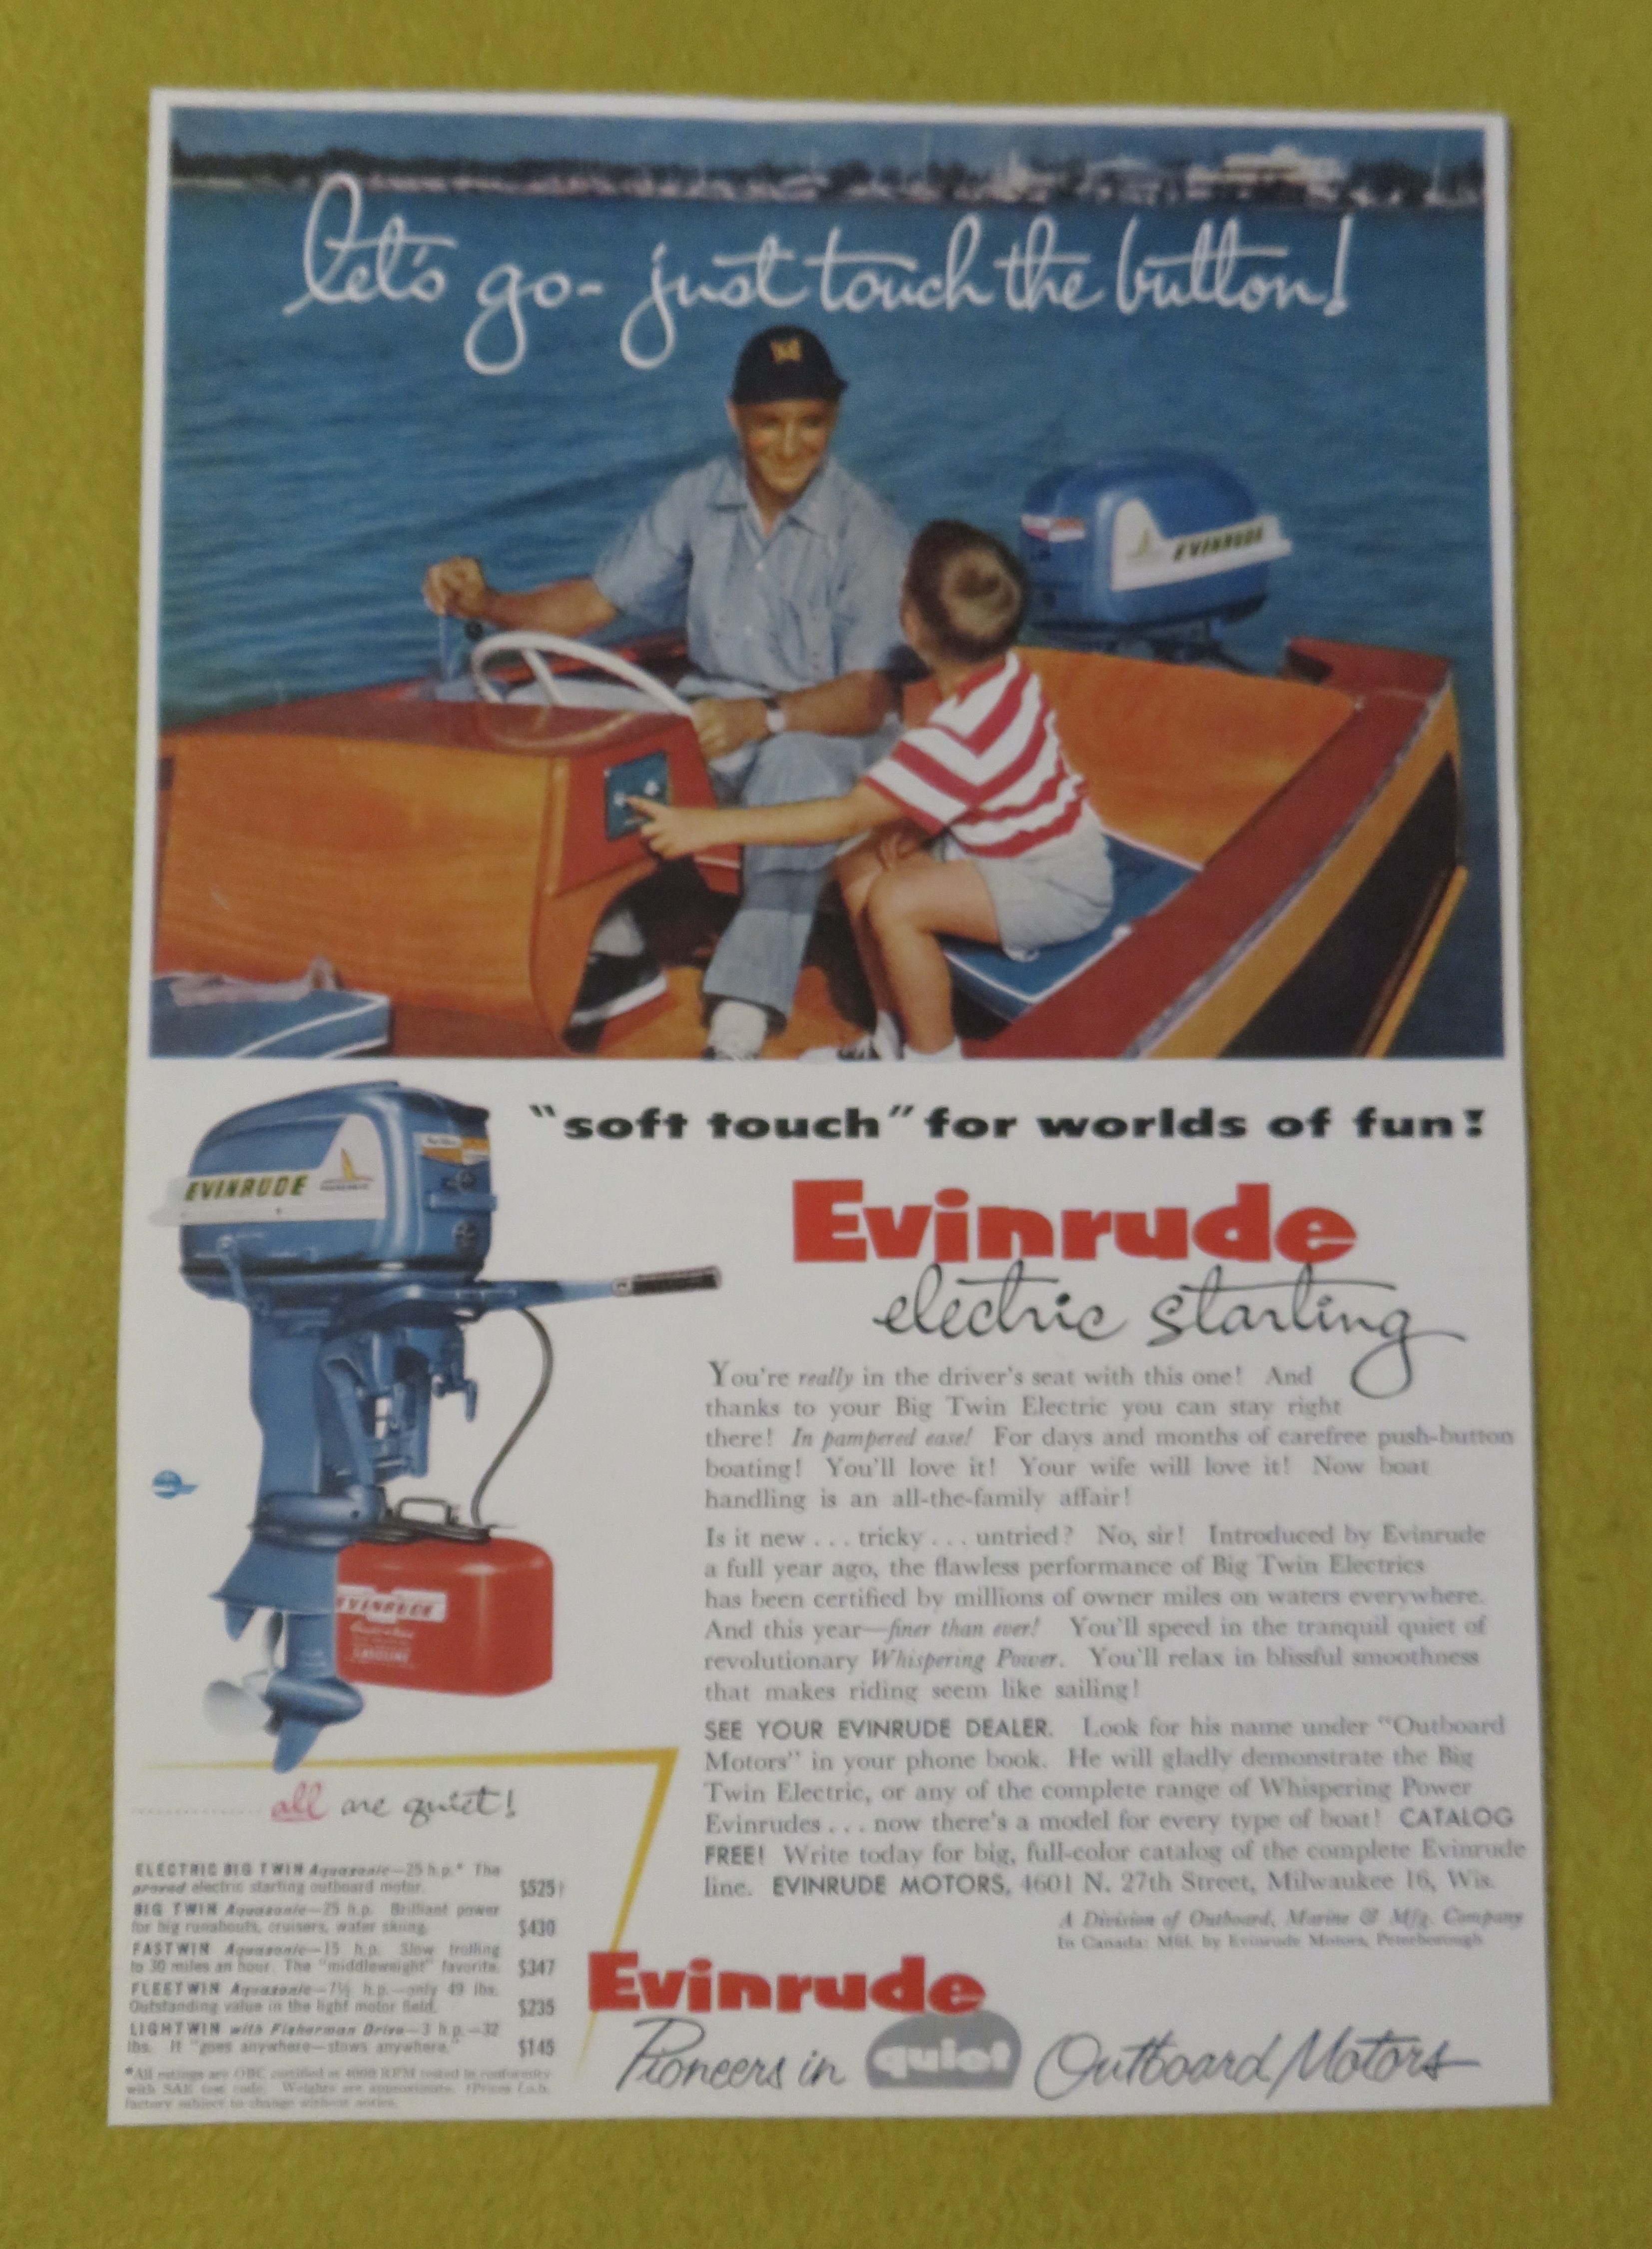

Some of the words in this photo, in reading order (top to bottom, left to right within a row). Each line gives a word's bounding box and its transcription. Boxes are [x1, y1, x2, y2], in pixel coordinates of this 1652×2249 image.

[619, 232, 810, 369] just
[802, 213, 994, 313] touch
[993, 214, 1105, 313] the
[1116, 213, 1353, 316] button!
[925, 1107, 1017, 1139] for
[1036, 1107, 1247, 1139] worlds
[1267, 1107, 1332, 1138] of
[1353, 1107, 1485, 1138] fun!
[185, 1173, 309, 1201] EVINRUDE
[792, 1179, 1358, 1263] Evinrude
[873, 1259, 1126, 1341] electric
[1146, 1263, 1467, 1399] starting
[709, 1360, 790, 1388] You're
[798, 1366, 854, 1392] really
[863, 1367, 885, 1386] in
[894, 1366, 930, 1386] the
[938, 1366, 1024, 1386] driver's
[1032, 1370, 1075, 1385] seat
[1084, 1366, 1134, 1386] with
[1144, 1366, 1184, 1386] this
[1191, 1365, 1242, 1386] one!
[1265, 1365, 1313, 1386] And
[705, 1398, 780, 1417] thanks
[793, 1402, 817, 1417] to
[829, 1403, 881, 1423] your
[895, 1395, 932, 1423] Big
[946, 1395, 1007, 1416] Twin
[1022, 1395, 1107, 1416] Electric
[1121, 1402, 1163, 1422] you
[1175, 1402, 1216, 1415] can
[1229, 1400, 1273, 1421] stay
[1287, 1396, 1341, 1421] right
[705, 1427, 773, 1447] there!
[791, 1427, 814, 1448] In
[821, 1427, 918, 1453] pampered
[925, 1427, 974, 1446] ease!
[994, 1425, 1033, 1447] For
[1041, 1426, 1094, 1452] days
[1102, 1426, 1145, 1446] and
[1155, 1426, 1239, 1446] months
[1247, 1426, 1271, 1445] of
[1277, 1426, 1368, 1445] carefree
[1377, 1425, 1515, 1451] push-button
[705, 1458, 802, 1484] boating!
[825, 1457, 895, 1478] You'll
[909, 1457, 956, 1477] love
[969, 1457, 996, 1477] it!
[1019, 1456, 1077, 1477] Your
[1090, 1456, 1136, 1476] wife
[1149, 1456, 1191, 1476] will
[1204, 1456, 1251, 1476] love
[1263, 1456, 1290, 1476] it!
[1313, 1455, 1365, 1475] Now
[1379, 1456, 1428, 1475] boat
[705, 1488, 807, 1514] handling
[820, 1488, 838, 1508] is
[850, 1494, 878, 1507] an
[892, 1487, 1045, 1513] all-the-family
[1059, 1486, 1130, 1506] affair!
[704, 1588, 742, 1608] has
[751, 1588, 805, 1608] been
[813, 1587, 907, 1608] certified
[917, 1586, 944, 1613] by
[954, 1586, 1045, 1607] millions
[1052, 1586, 1076, 1606] of
[1082, 1591, 1154, 1606] owner
[1163, 1585, 1222, 1606] miles
[1229, 1592, 1259, 1605] on
[1267, 1590, 1341, 1604] waters
[1348, 1585, 1485, 1610] everywhere.
[704, 1681, 750, 1701] that
[765, 1681, 836, 1701] makes
[849, 1680, 919, 1706] riding
[931, 1685, 988, 1699] seem
[1002, 1678, 1042, 1699] like
[1055, 1677, 1139, 1705] sailing!
[704, 1719, 743, 1741] SEE
[756, 1718, 824, 1741] YOUR
[837, 1717, 952, 1740] EVINRUDE
[965, 1716, 1054, 1738] DEALER.
[1083, 1716, 1139, 1737] Look
[1149, 1716, 1180, 1736] for
[1190, 1716, 1221, 1736] his
[1230, 1721, 1293, 1736] name
[1302, 1715, 1369, 1736] under
[1378, 1714, 1506, 1735] "Outboard
[270, 1781, 329, 1823] all
[340, 1796, 393, 1818] are
[403, 1784, 516, 1828] quiet!
[703, 1875, 753, 1898] line.
[772, 1874, 887, 1897] EVINRUDE
[899, 1872, 1012, 1896] MOTORS,
[1021, 1873, 1072, 1894] 4601
[1084, 1871, 1111, 1894] N.
[1121, 1871, 1172, 1893] 27th
[1181, 1871, 1256, 1894] Street,
[1267, 1864, 1395, 1891] Milwaukee
[1407, 1869, 1437, 1892] 16,
[1447, 1869, 1494, 1888] Wis.
[519, 1917, 555, 1938] $430
[519, 1958, 555, 1978] $347
[588, 1951, 987, 2015] Evinrude
[518, 1998, 555, 2018] $235
[518, 2038, 555, 2058] $145
[615, 2017, 785, 2092] Pioneers
[797, 2050, 846, 2087] in
[872, 2038, 1011, 2079] quiet
[1034, 2030, 1283, 2101] Outboard
[1265, 2025, 1481, 2100] Motors
